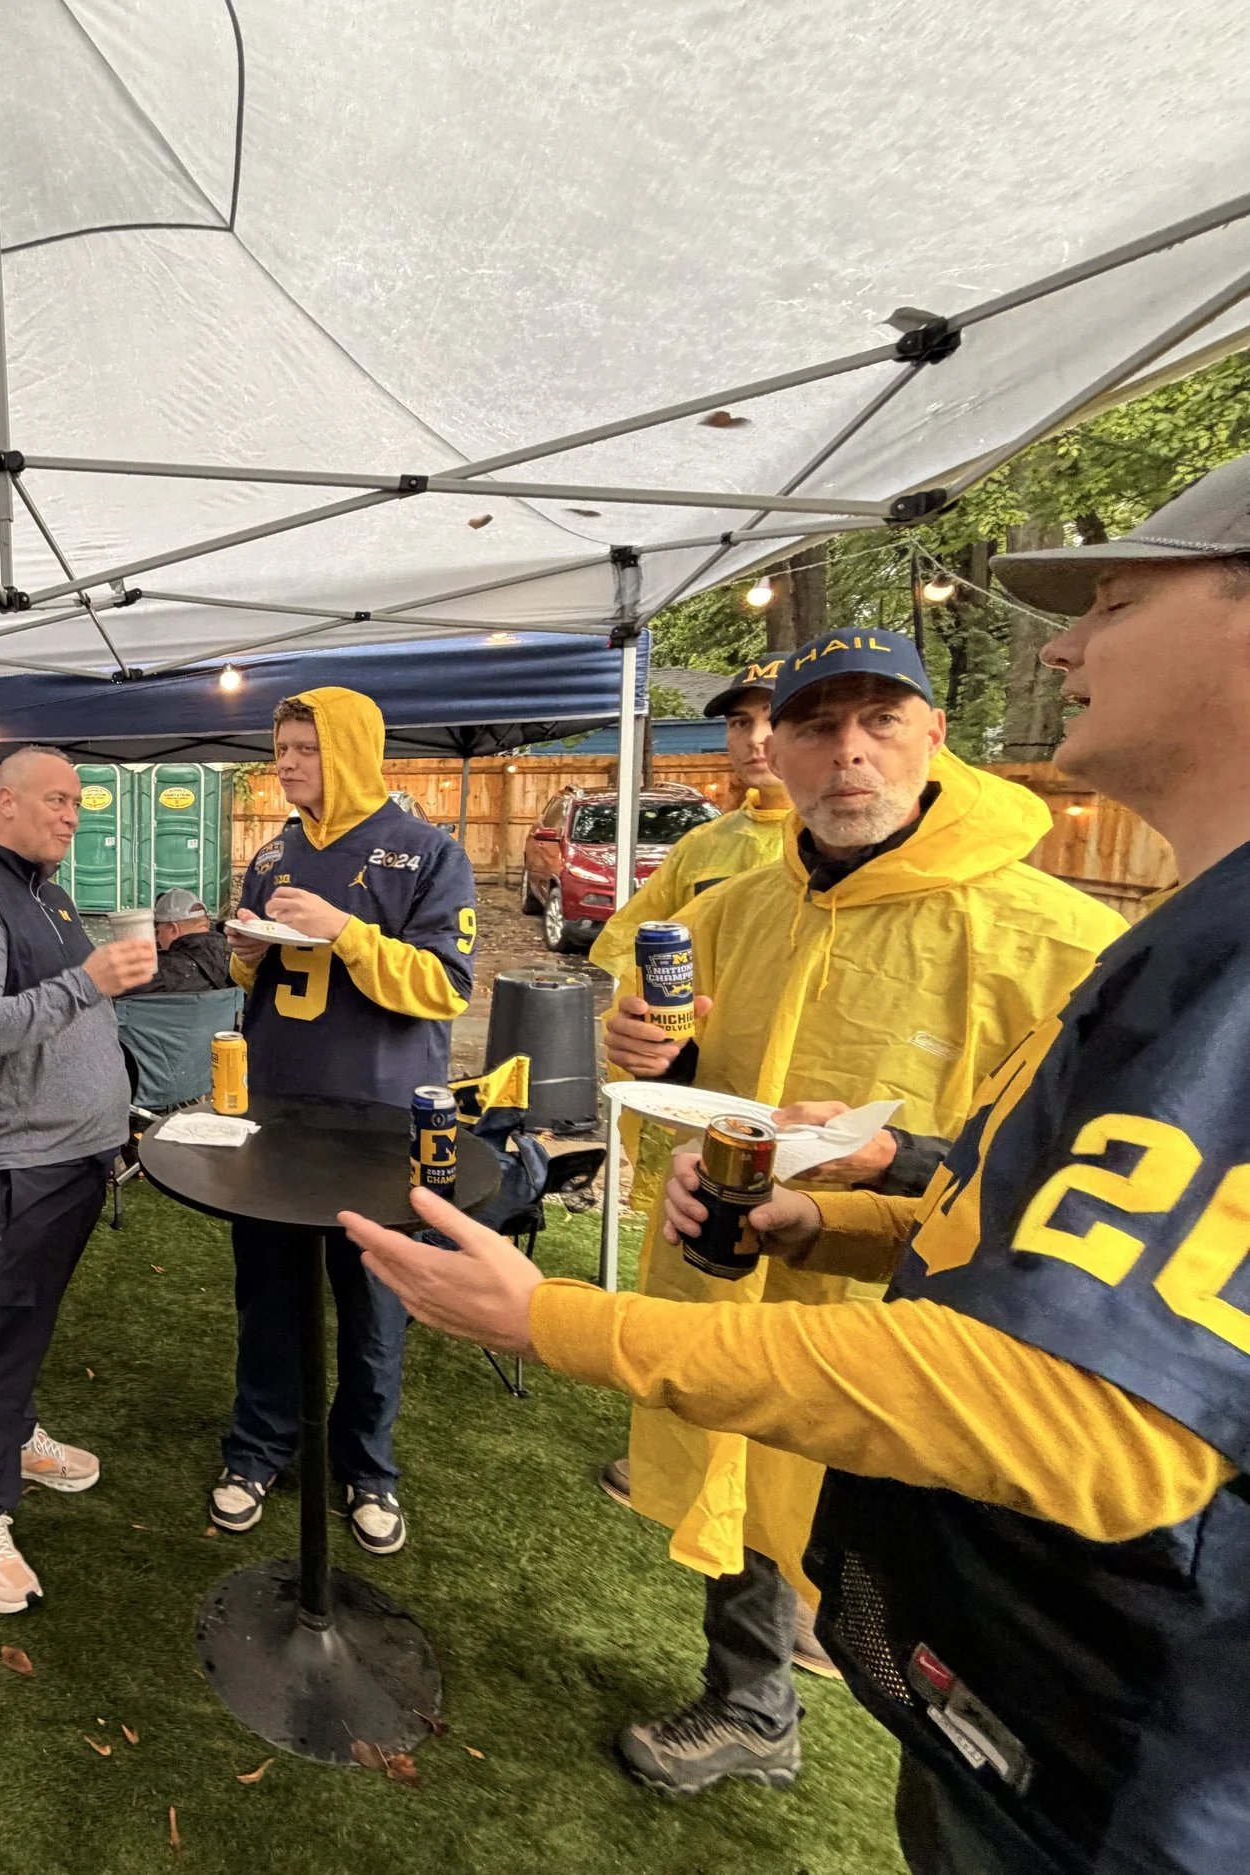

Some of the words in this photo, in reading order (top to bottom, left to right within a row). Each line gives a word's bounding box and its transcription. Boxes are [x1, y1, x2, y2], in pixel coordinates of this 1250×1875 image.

[794, 636, 891, 672] HAIL
[742, 660, 786, 684] M
[456, 907, 478, 955] 9
[653, 963, 693, 975] NATION
[672, 952, 689, 965] M
[274, 943, 332, 1021] 9
